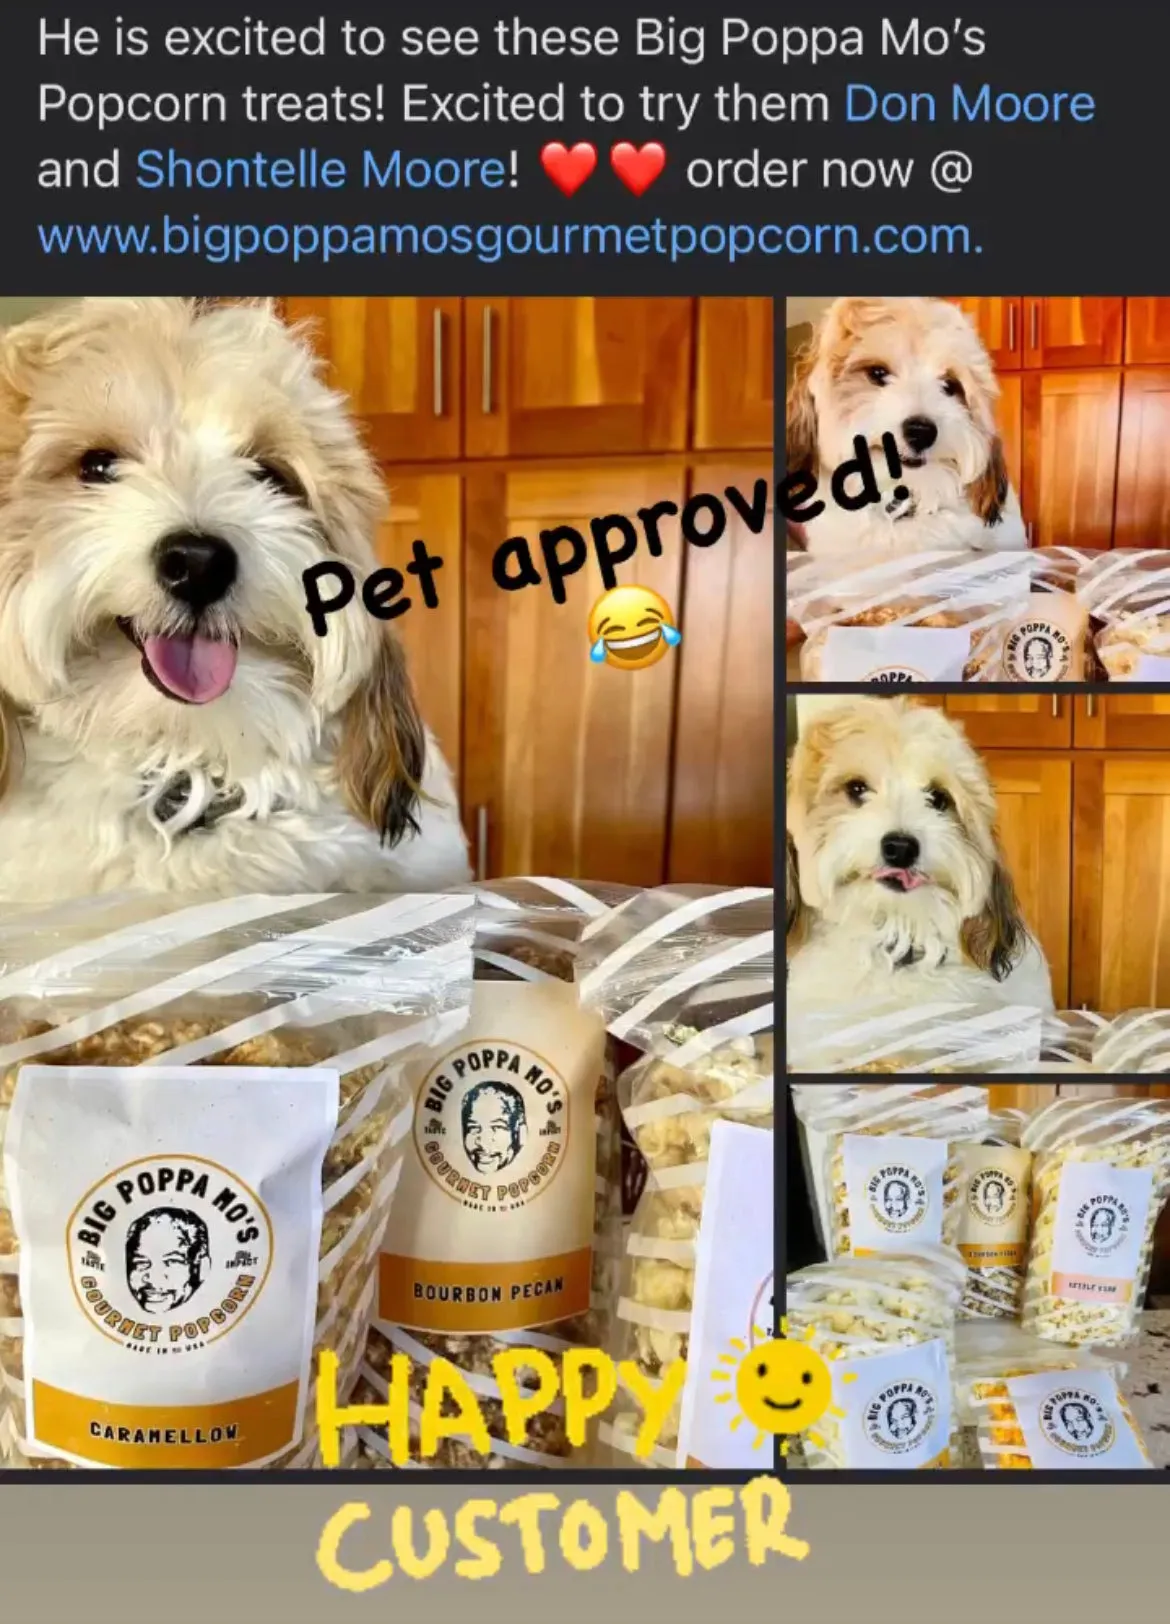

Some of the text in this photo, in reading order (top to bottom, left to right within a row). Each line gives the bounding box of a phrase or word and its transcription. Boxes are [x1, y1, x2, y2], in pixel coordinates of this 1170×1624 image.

[424, 1049, 563, 1115] BIG POPPA MO'S
[424, 1141, 561, 1200] GOURMET POPCORN
[78, 1167, 259, 1248] BIG POPPA MO'S
[81, 1274, 256, 1342] GOURMET POPCORN
[413, 1277, 564, 1302] BOURBON PECAN
[90, 1421, 239, 1443] CARAMELLOW
